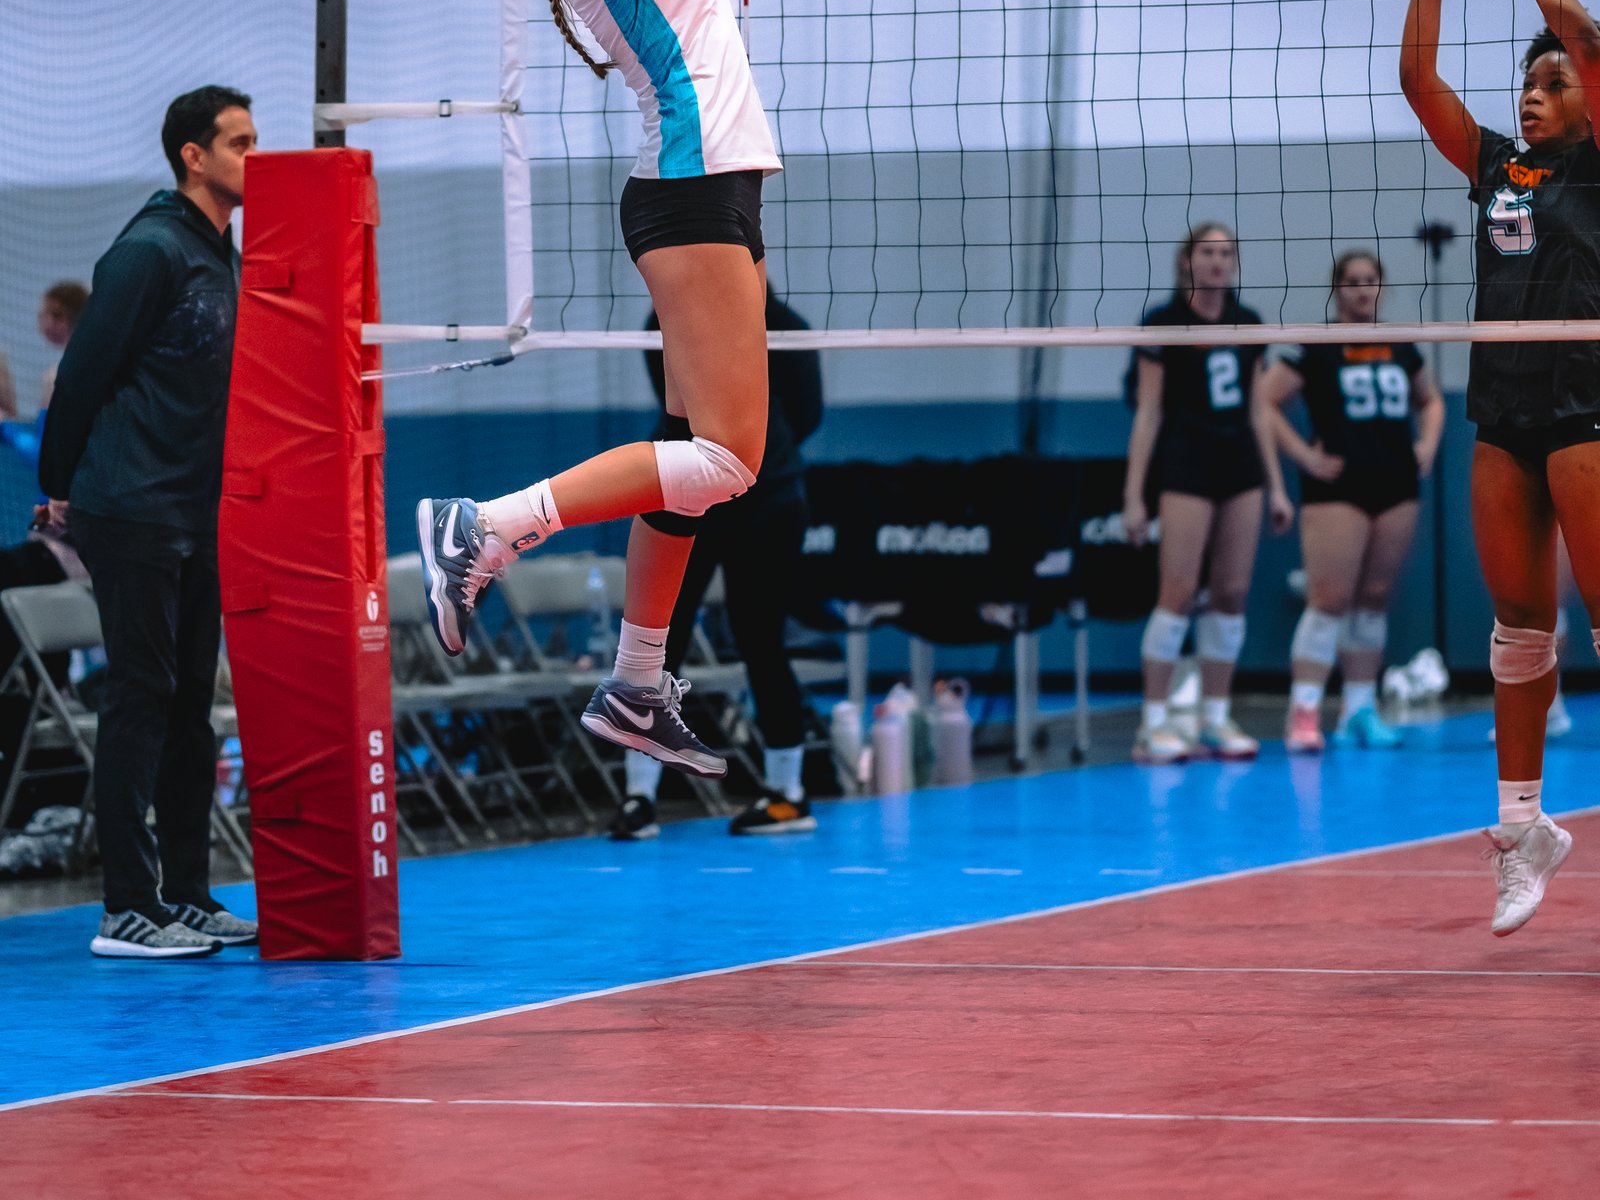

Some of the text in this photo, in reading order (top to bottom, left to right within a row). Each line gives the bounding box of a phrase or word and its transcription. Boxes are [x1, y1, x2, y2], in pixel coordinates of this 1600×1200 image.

[1487, 184, 1536, 255] 5
[1207, 349, 1242, 409] 2
[1339, 362, 1409, 420] 59
[368, 730, 388, 878] senoh
